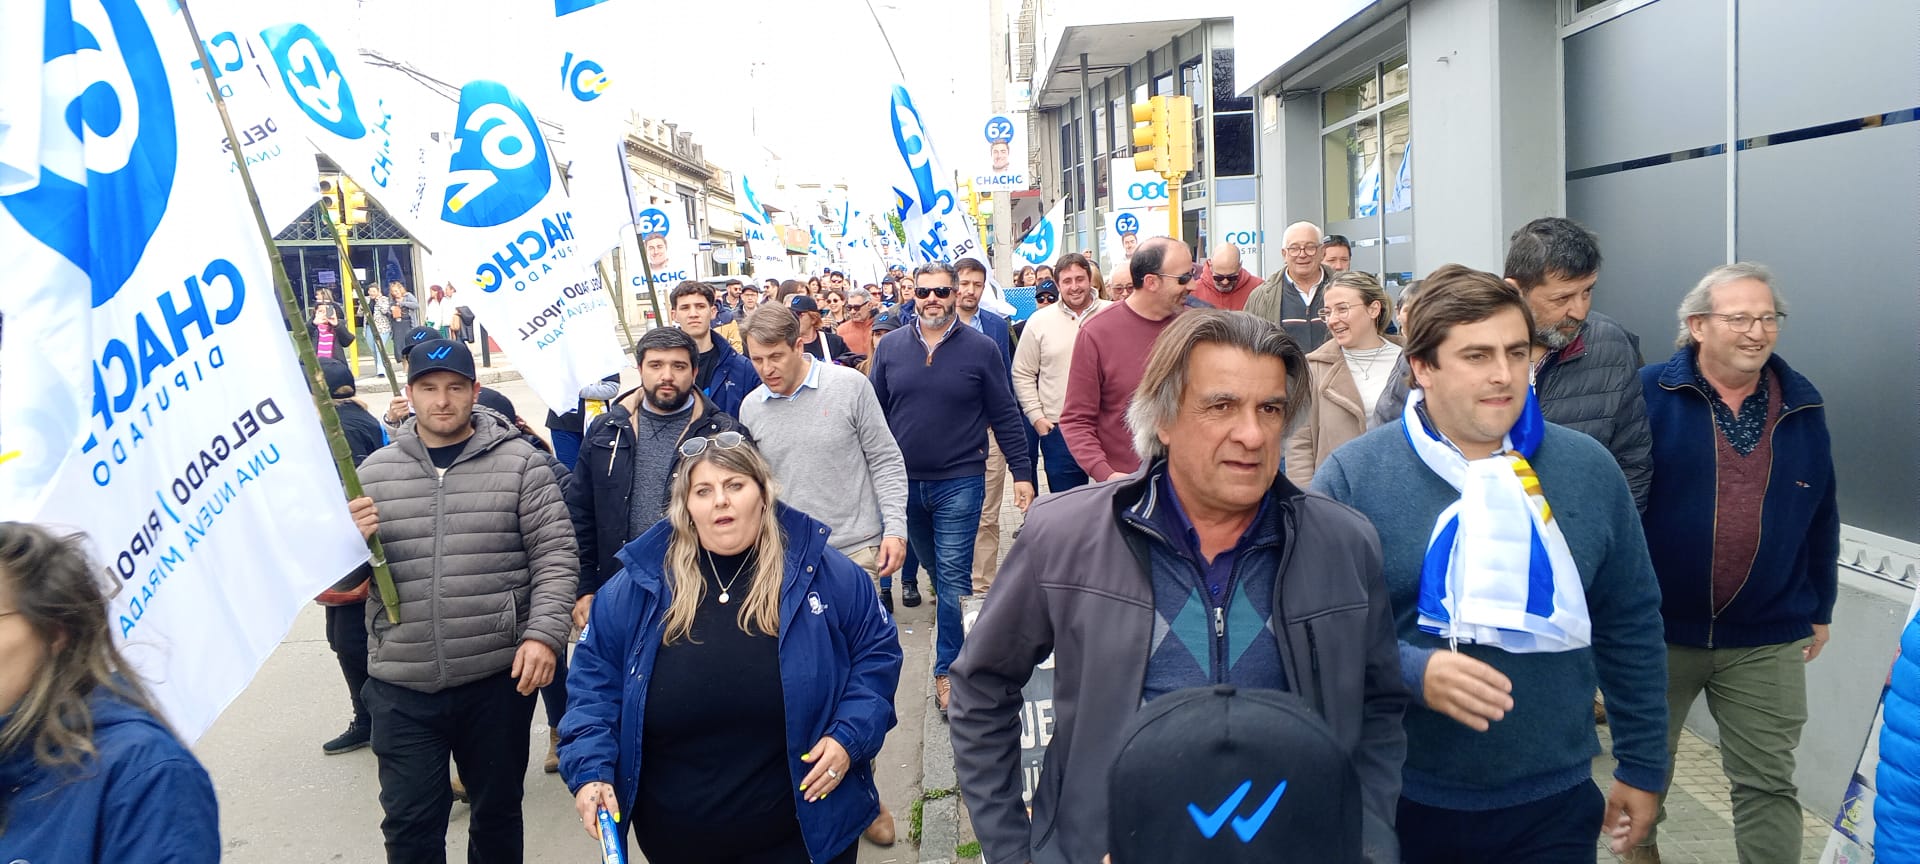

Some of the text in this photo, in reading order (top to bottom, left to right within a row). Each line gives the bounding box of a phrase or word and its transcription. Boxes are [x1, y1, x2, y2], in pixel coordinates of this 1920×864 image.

[987, 122, 1011, 139] 62
[639, 214, 667, 234] 62
[1117, 217, 1137, 232] 62
